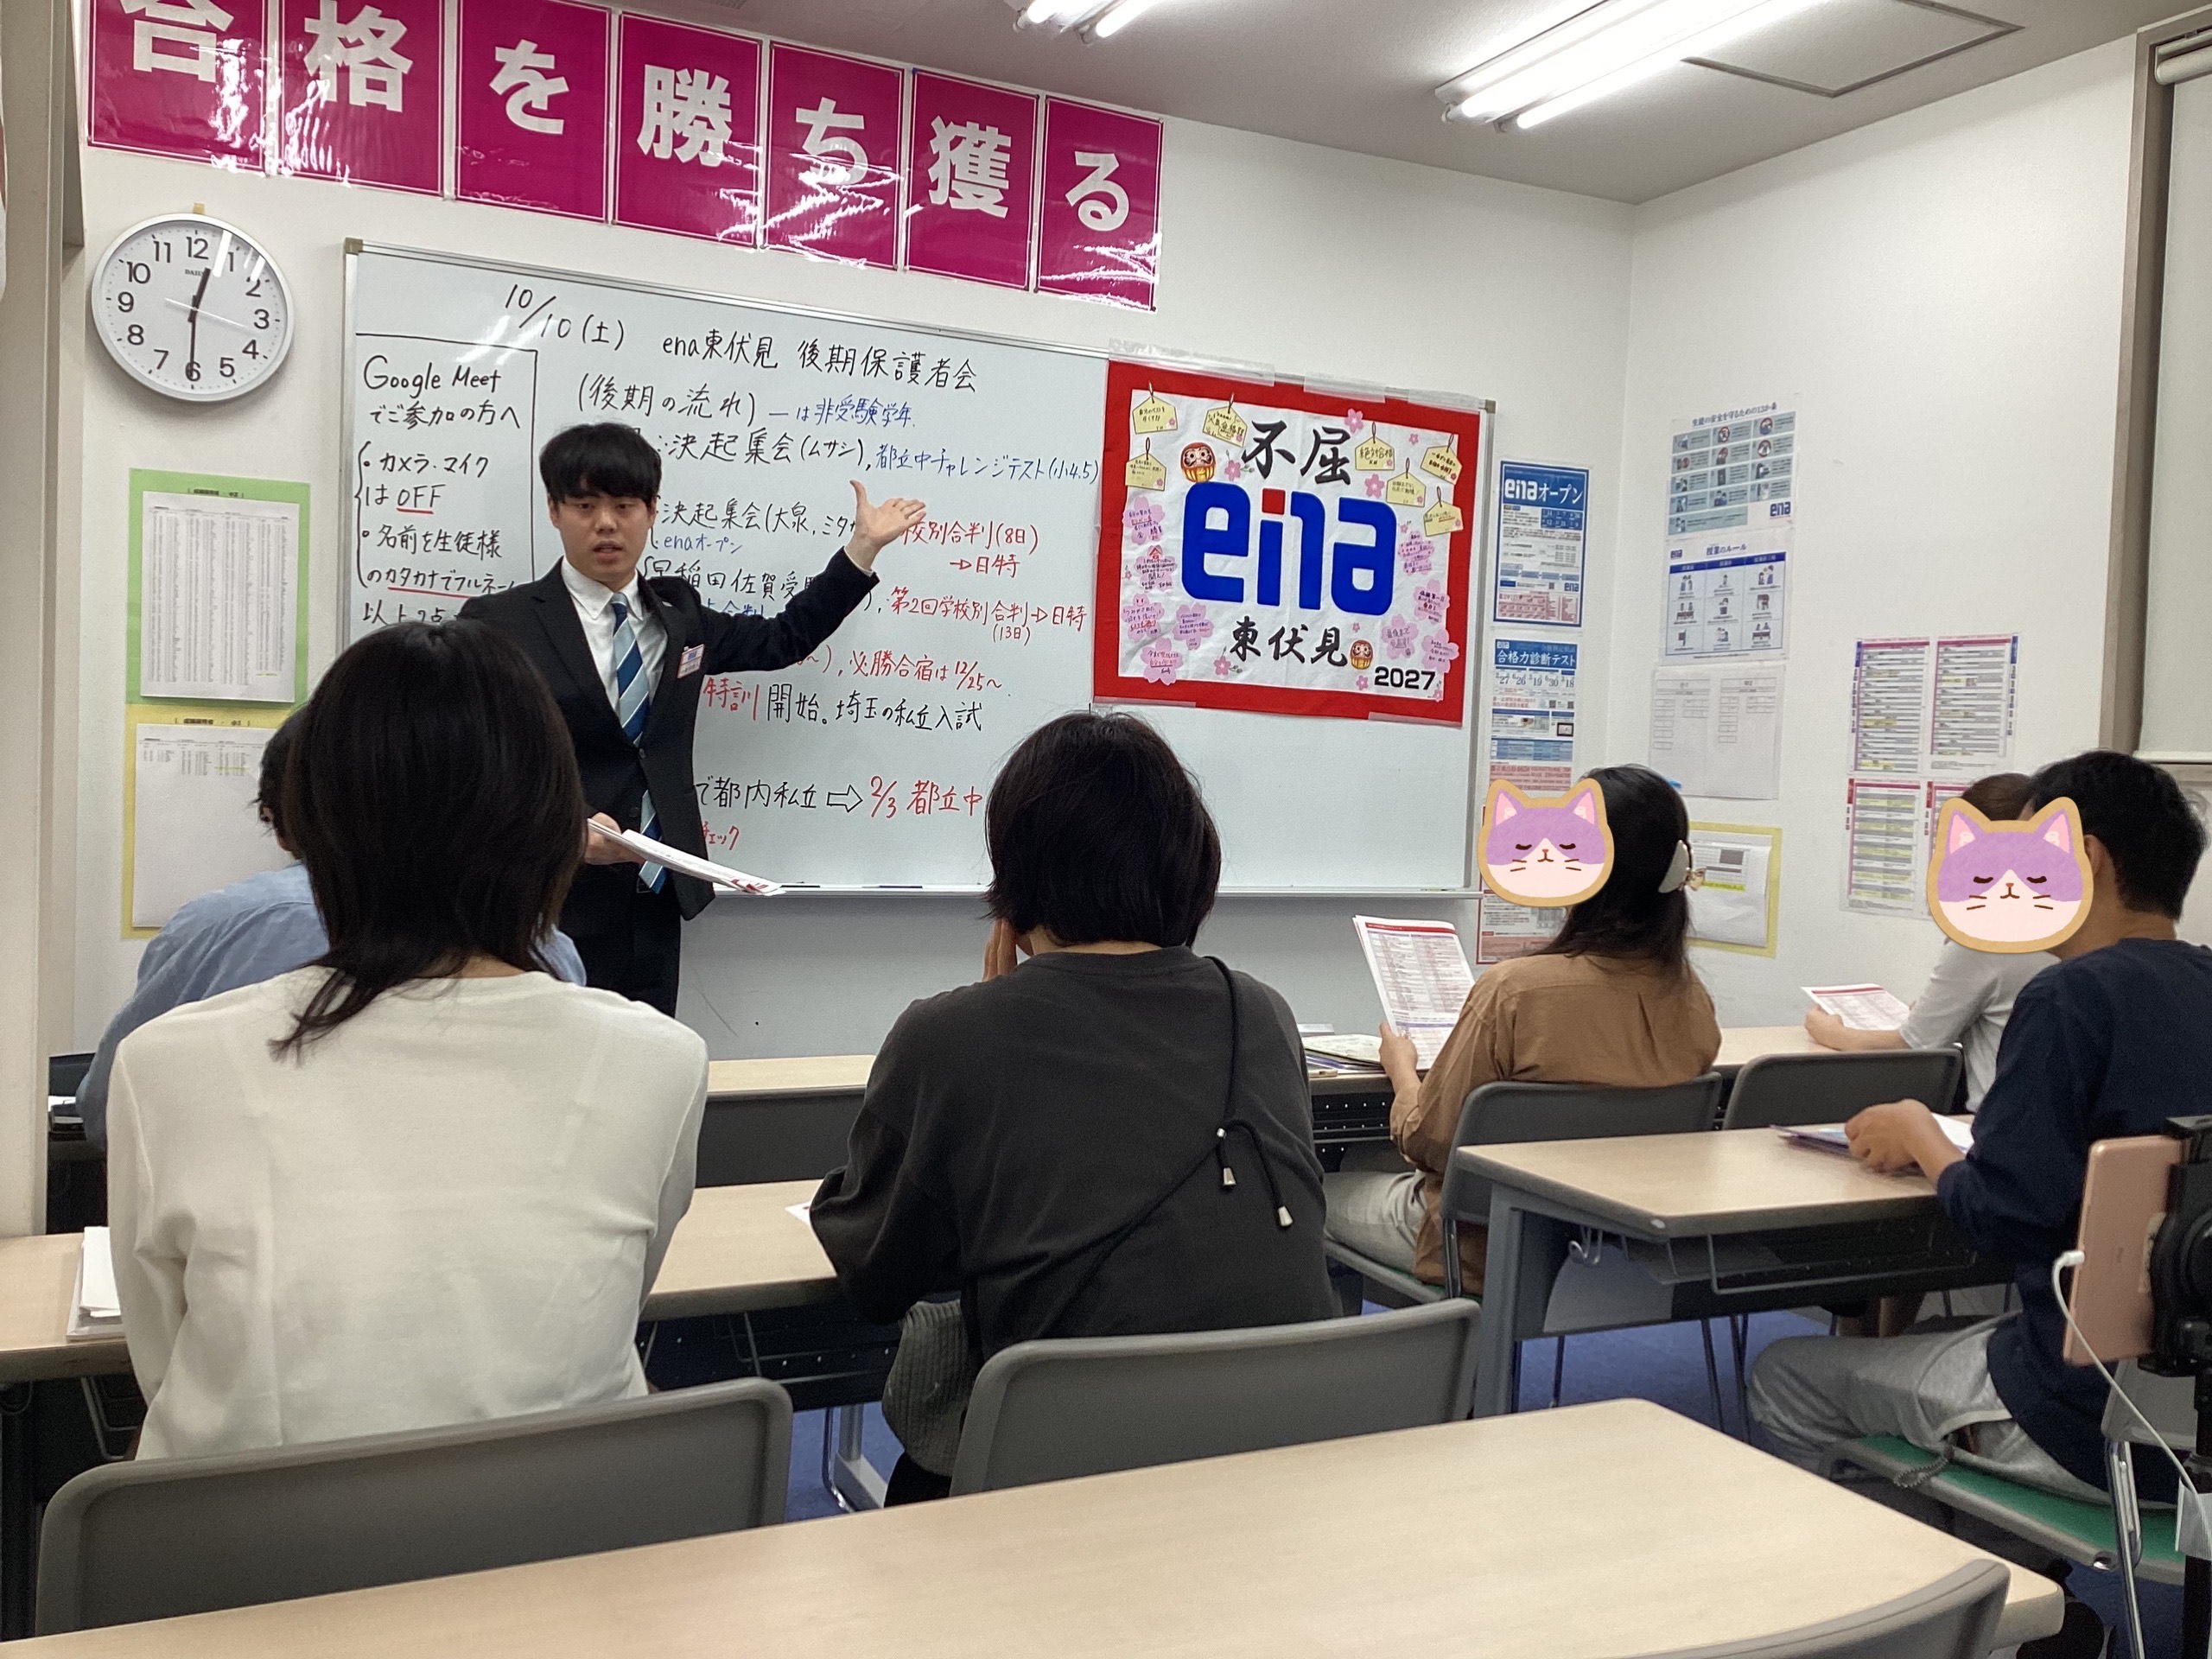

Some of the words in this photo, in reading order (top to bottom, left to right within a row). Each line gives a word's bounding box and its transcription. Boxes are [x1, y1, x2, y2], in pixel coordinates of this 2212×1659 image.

[153, 240, 171, 264] 11
[186, 236, 208, 260] 12
[127, 261, 151, 284] 10
[227, 251, 234, 272] 1
[118, 291, 135, 313] 9
[253, 308, 270, 330] 3
[127, 324, 144, 346] 8
[154, 348, 169, 370] 7
[242, 340, 259, 359] 4
[662, 329, 779, 370] ena東伏見
[797, 338, 977, 392] 後期保護者会
[219, 356, 235, 378] 5
[364, 355, 442, 398] Google
[451, 365, 501, 392] Meet
[369, 398, 521, 429] でご参加の方へ
[1241, 420, 1352, 486] 不屈
[1770, 501, 1791, 517] ena
[377, 524, 503, 560] 名前を生徒様
[1181, 480, 1397, 617] ena
[366, 567, 515, 594] のカタカナでフルネー
[1229, 615, 1348, 668] 東伏見
[1497, 650, 1576, 667] 合格力診断テスト
[1374, 665, 1436, 691] 2027
[906, 779, 983, 817] 都立中
